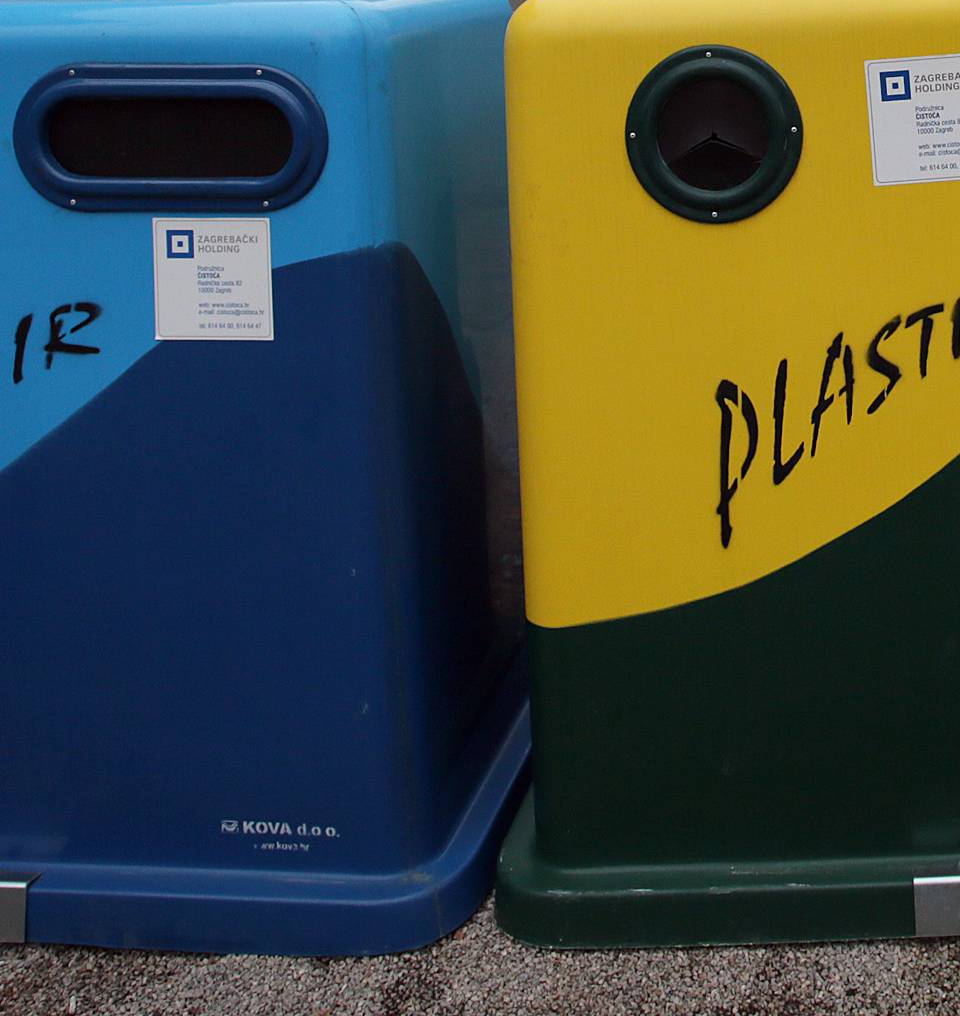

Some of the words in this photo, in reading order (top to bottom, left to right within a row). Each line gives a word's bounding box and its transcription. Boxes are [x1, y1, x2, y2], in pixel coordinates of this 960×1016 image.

[915, 82, 960, 93] HOLDING
[917, 127, 934, 135] 10000
[935, 126, 953, 135] Zagreb
[197, 234, 258, 244] ZAGREBAČKI
[198, 245, 240, 253] HOLDING
[242, 821, 292, 835] KOVA
